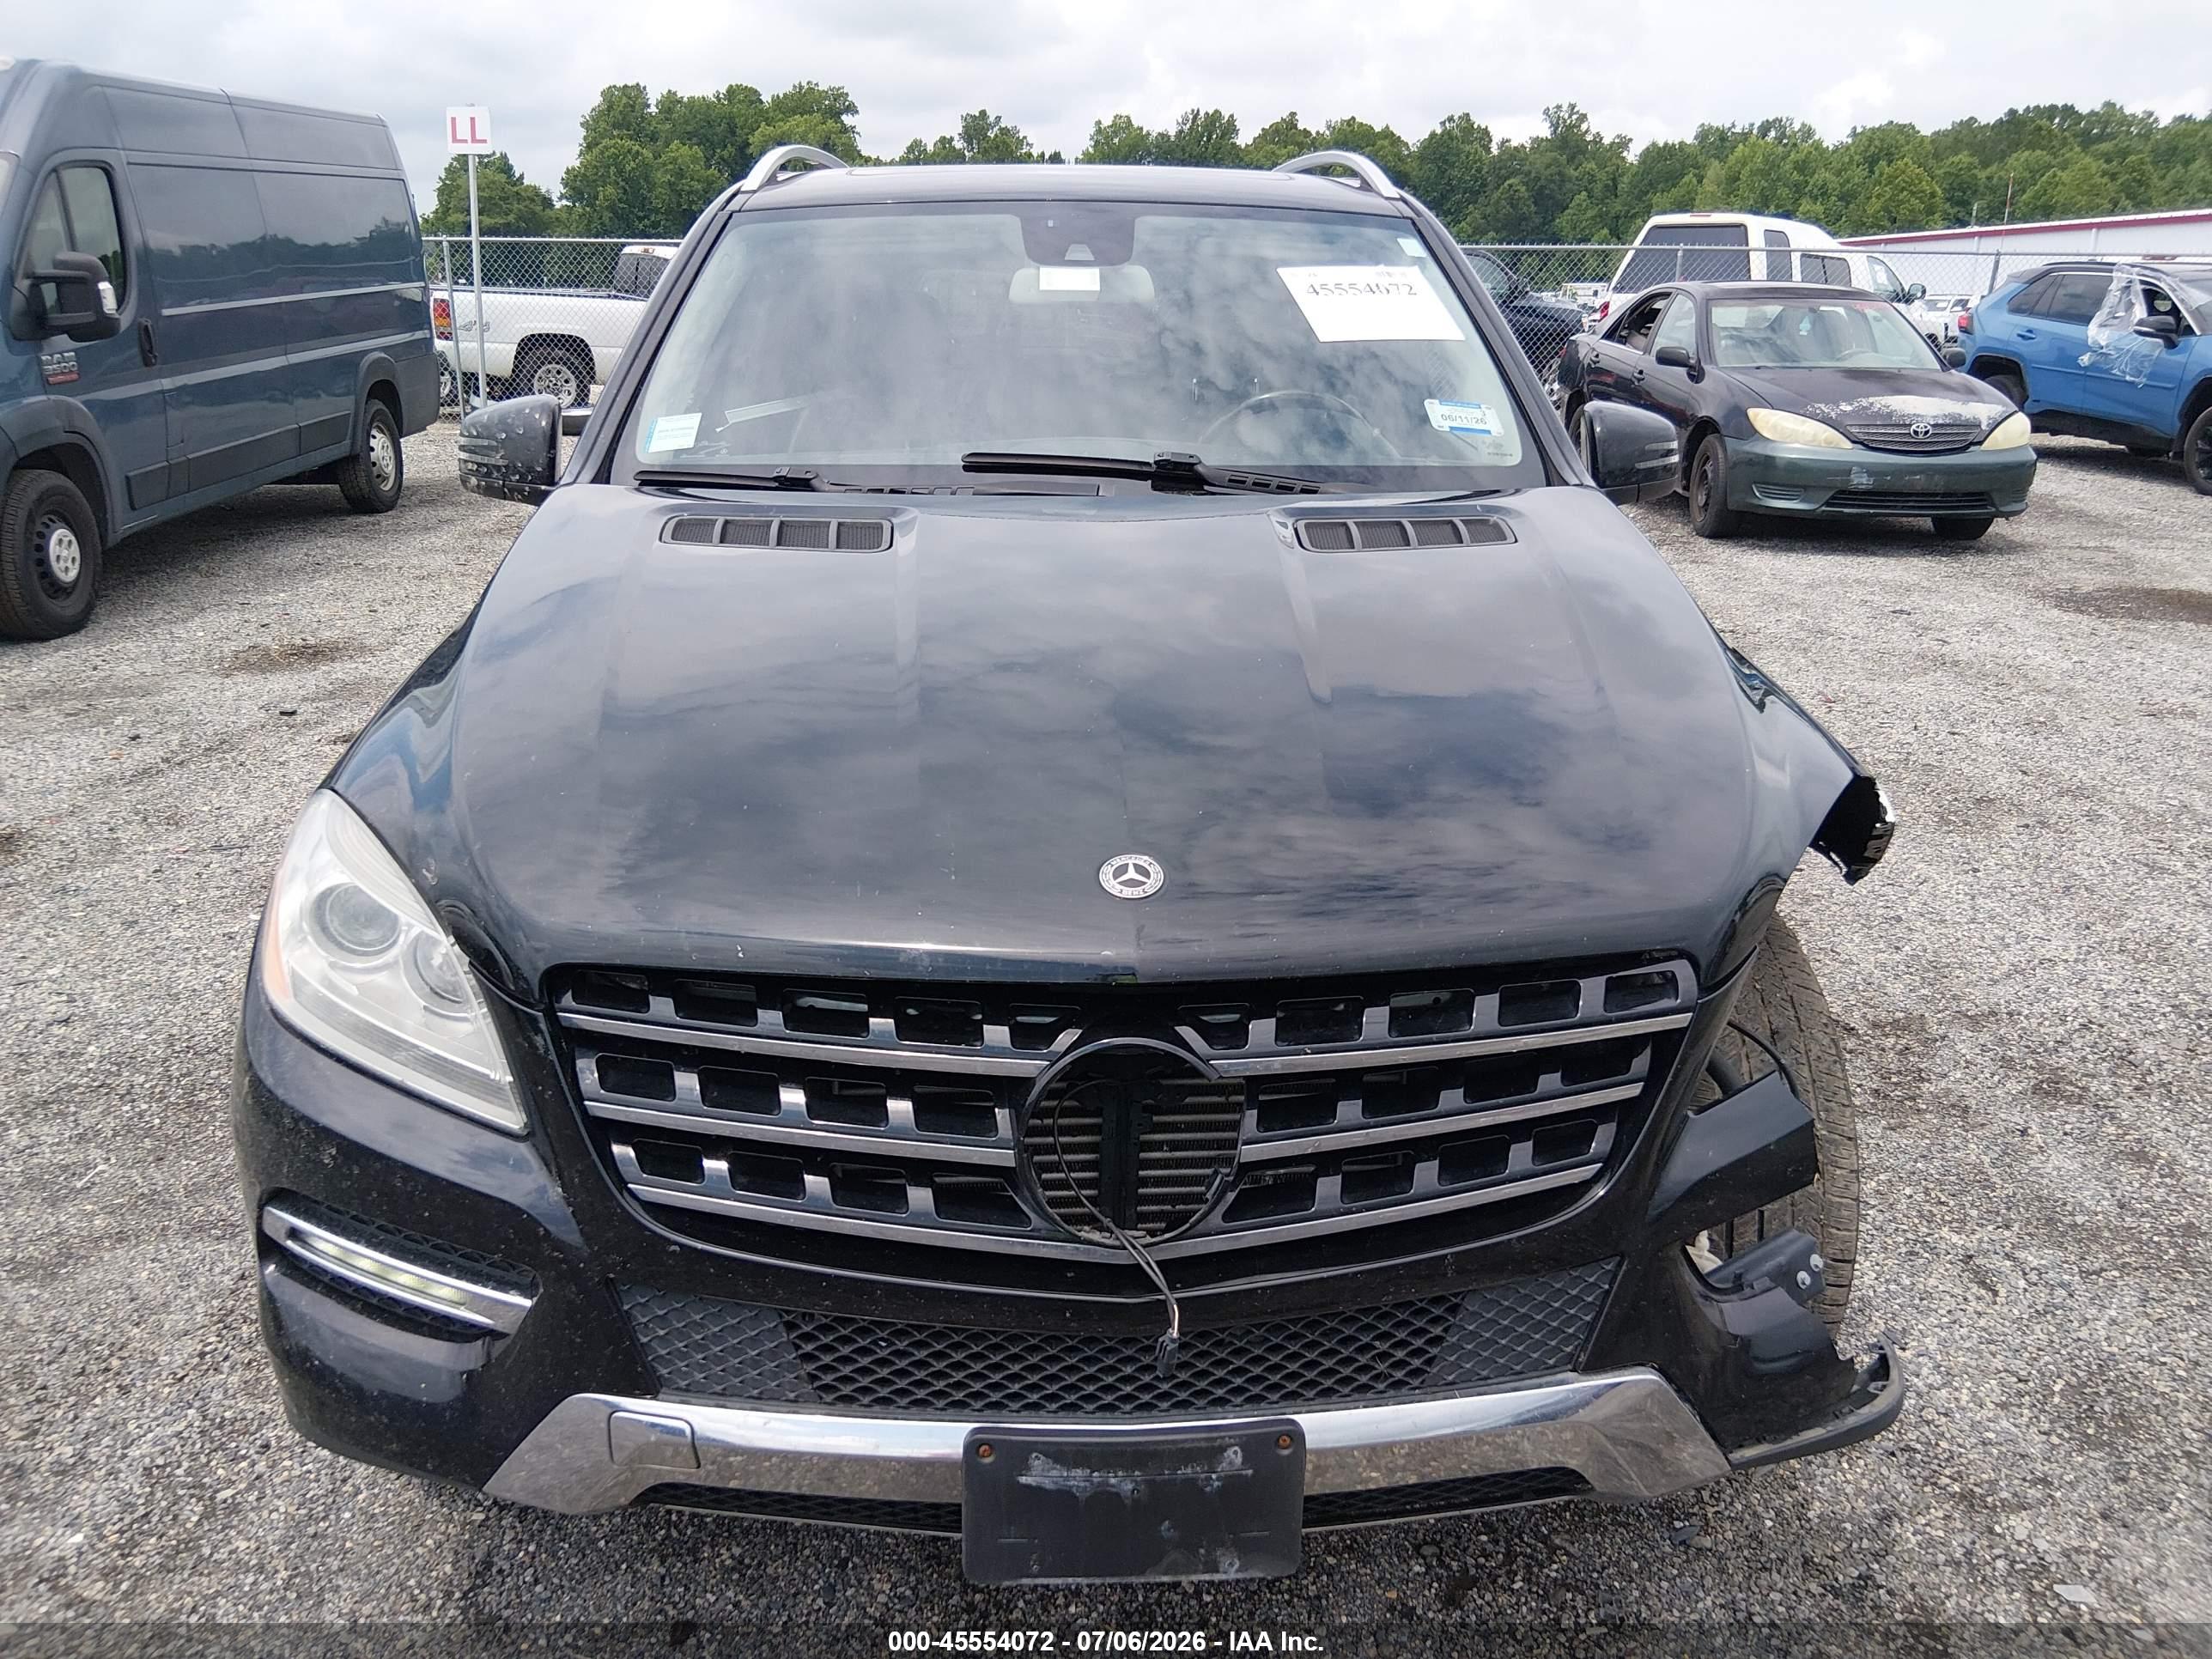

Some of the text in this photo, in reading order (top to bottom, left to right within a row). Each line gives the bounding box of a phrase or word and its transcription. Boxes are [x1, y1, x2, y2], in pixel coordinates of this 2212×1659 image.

[451, 116, 488, 144] LL
[41, 351, 76, 365] RAM
[43, 362, 77, 374] 3500
[1441, 413, 1487, 425] 06/11/26
